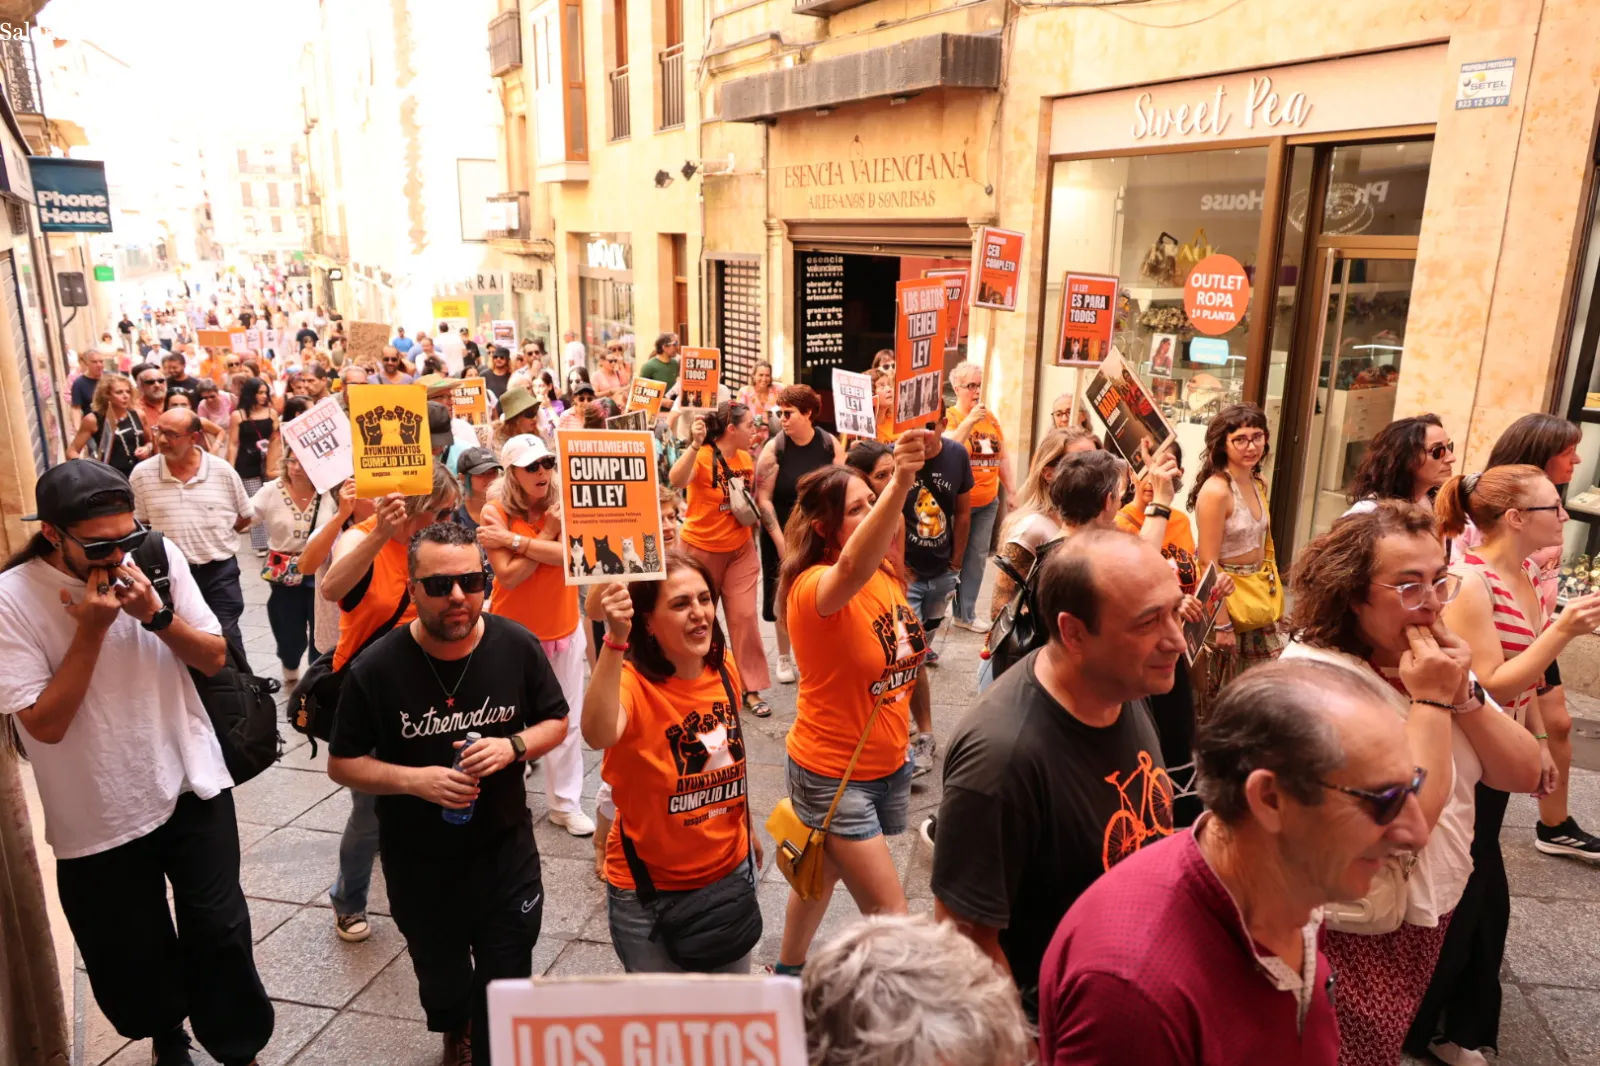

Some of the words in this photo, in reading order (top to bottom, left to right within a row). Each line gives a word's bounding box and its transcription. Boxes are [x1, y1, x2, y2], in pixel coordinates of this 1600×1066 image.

[1470, 80, 1507, 90] SETEL
[1131, 84, 1232, 139] Sweet
[1244, 76, 1313, 128] Pea
[1458, 99, 1472, 108] 923
[785, 161, 844, 188] ESENCIA
[850, 150, 971, 184] VALENCIANA
[36, 190, 107, 207] Phone
[808, 192, 865, 210] ARTESANOS
[878, 189, 936, 208] SONRISAS
[40, 207, 109, 224] House
[806, 255, 844, 264] esencia
[806, 264, 844, 272] valenciana
[986, 258, 1016, 272] COMPLETO
[1191, 273, 1244, 290] OUTLET
[903, 290, 919, 313] LOS
[919, 287, 945, 311] GATOS
[1071, 294, 1083, 307] ES
[1084, 295, 1106, 309] PARA
[1196, 291, 1233, 308] ROPA
[1070, 310, 1096, 323] TODOS
[1202, 309, 1235, 321] PLANTA
[806, 358, 843, 367] gofres
[912, 340, 930, 369] LEY
[686, 359, 694, 368] ES
[696, 359, 713, 369] PARA
[686, 371, 706, 380] TODOS
[464, 387, 480, 395] PARA
[633, 395, 650, 404] TODOS
[635, 386, 642, 394] ES
[643, 388, 658, 397] PARA
[287, 423, 308, 440] LOS
[307, 403, 337, 428] GATOS
[299, 419, 336, 447] TIENEN
[311, 434, 336, 458] LEY
[364, 445, 421, 456] AYUNTAMIENTOS
[568, 440, 645, 453] AYUNTAMIENTOS
[362, 456, 398, 468] CUMPLID
[400, 456, 409, 466] LA
[411, 455, 424, 465] LEY
[570, 457, 646, 480] CUMPLID
[572, 485, 593, 507] LA
[596, 485, 624, 506] LEY
[400, 696, 515, 739] Extremoduro
[676, 763, 744, 793] AYUNTAMIENT
[670, 786, 723, 812] CUMPLID
[725, 781, 738, 799] LA
[517, 1023, 605, 1066] LOS
[621, 1020, 776, 1066] GATOS
